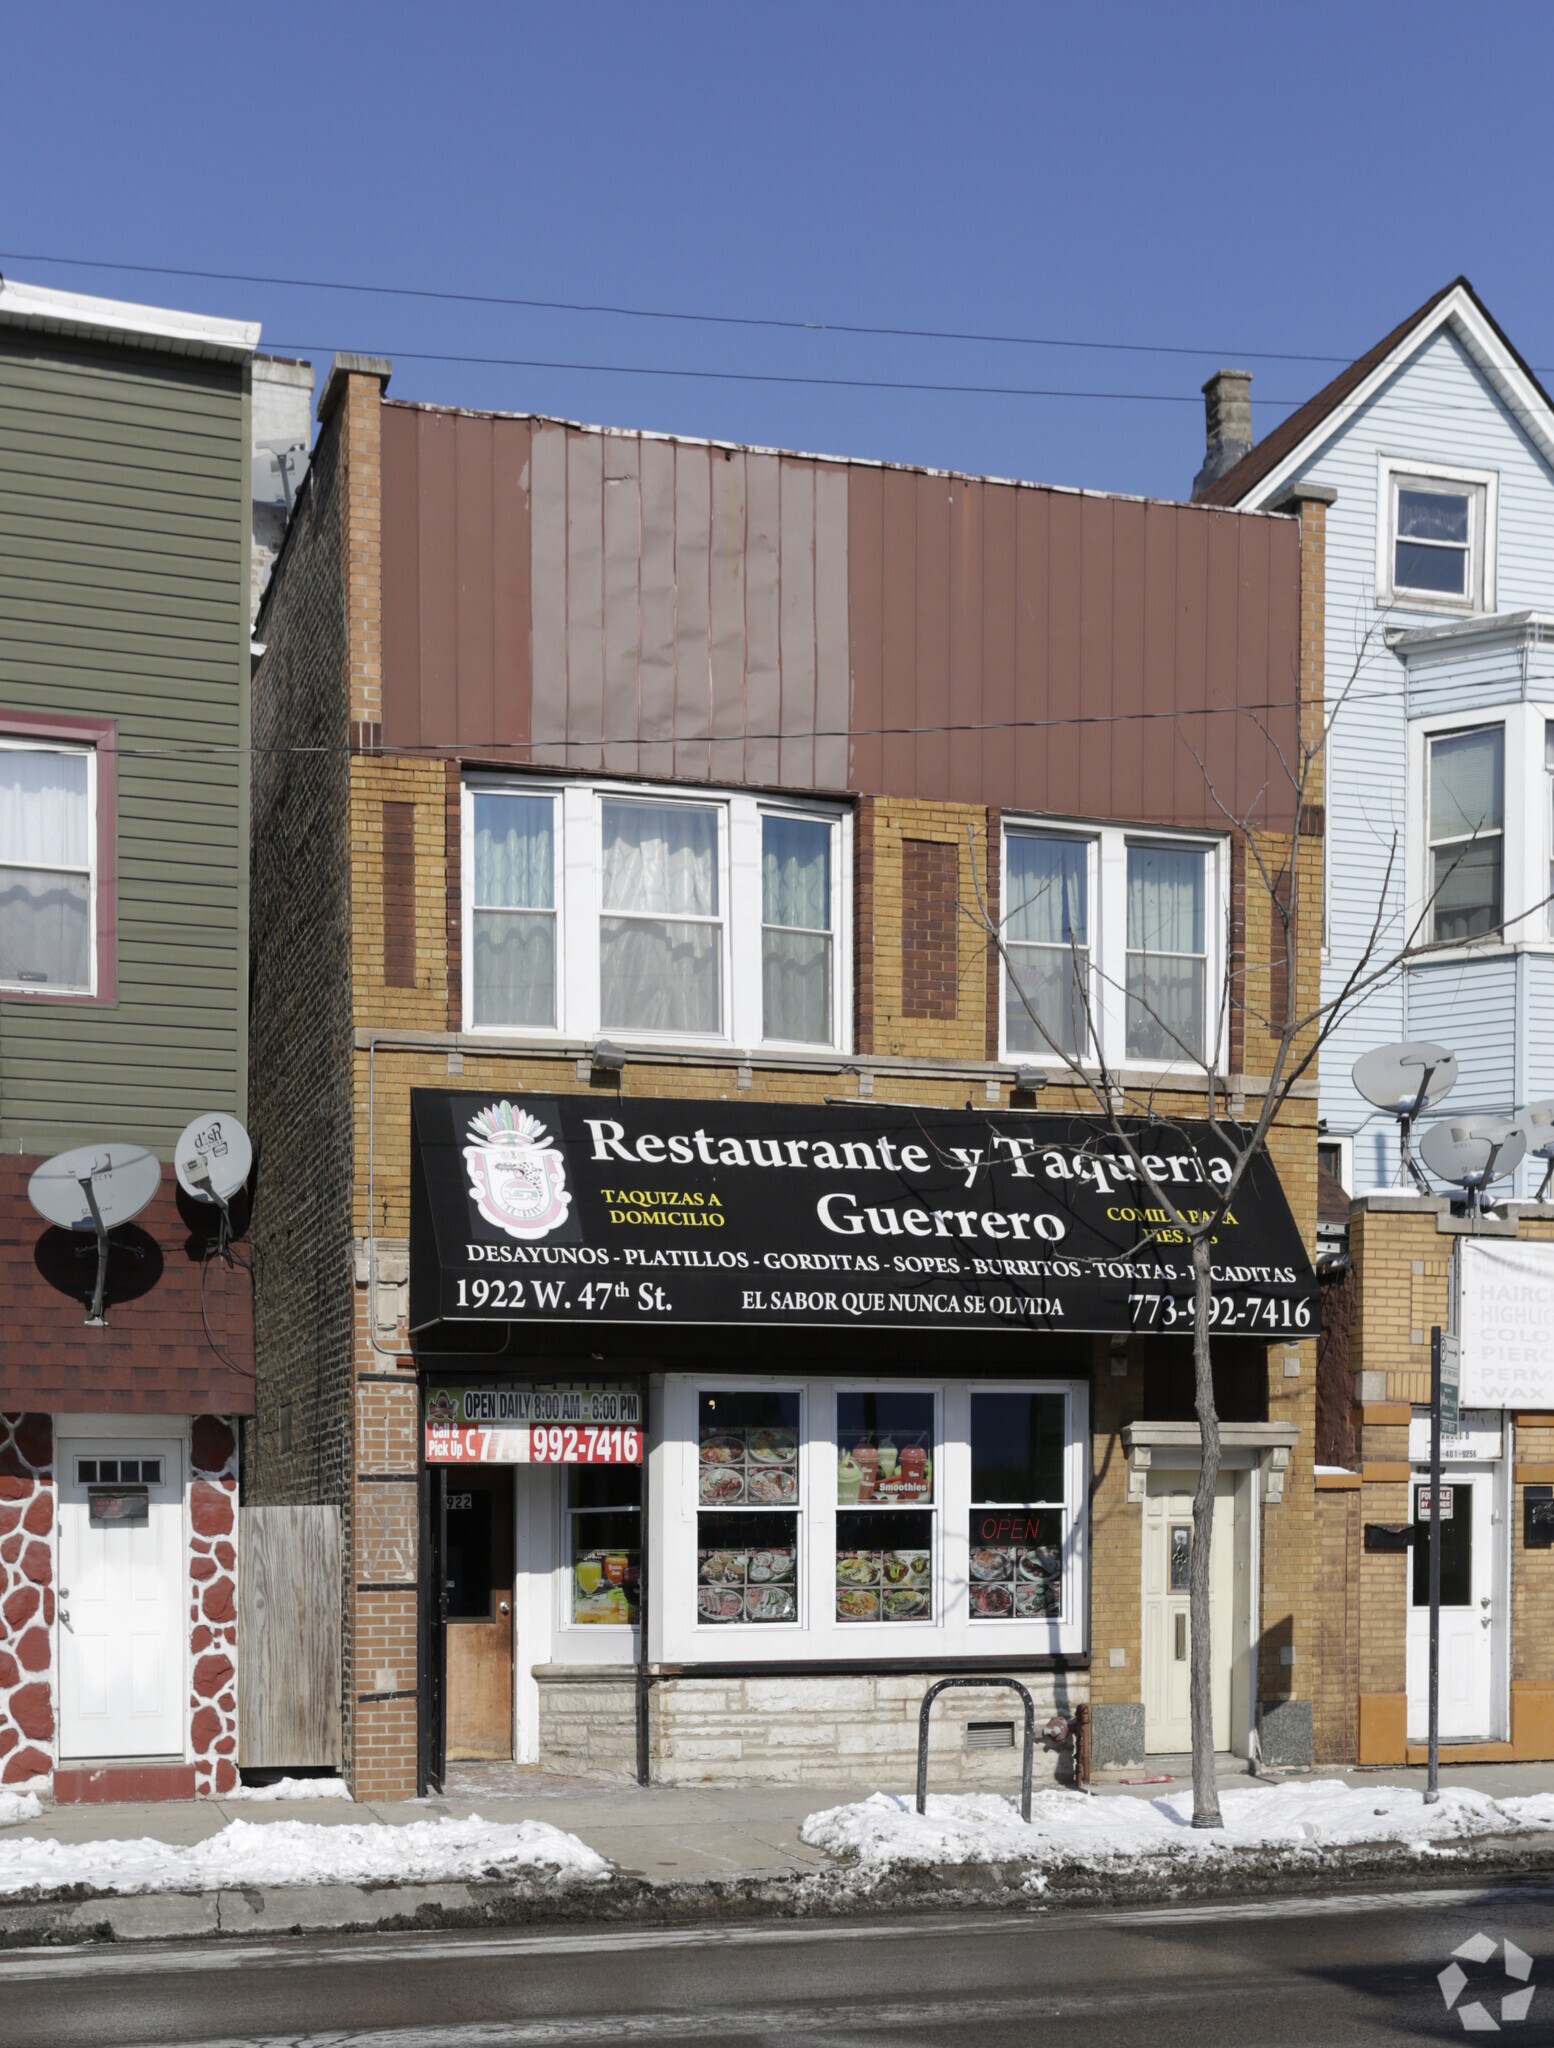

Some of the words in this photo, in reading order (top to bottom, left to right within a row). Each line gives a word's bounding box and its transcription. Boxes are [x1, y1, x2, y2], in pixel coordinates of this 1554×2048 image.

[194, 1127, 222, 1149] dish
[583, 1118, 931, 1173] Restaurante
[949, 1147, 984, 1188] y
[993, 1137, 1235, 1193] Taqueria
[601, 1189, 704, 1207] TAQUIZAS
[708, 1193, 723, 1206] A
[609, 1210, 725, 1227] DOMICILIO
[816, 1192, 1066, 1241] Guerrero
[1187, 1209, 1240, 1225] PAA
[1142, 1228, 1219, 1245] FIESS
[466, 1243, 609, 1265] DESAYUNOS
[624, 1248, 749, 1270] PLATILLOS
[763, 1253, 879, 1272] GORDITAS
[893, 1255, 960, 1275] SOPES
[973, 1258, 1081, 1278] BURRITOS
[1092, 1262, 1176, 1281] TORTAS
[1187, 1265, 1297, 1284] CADITAS
[456, 1279, 527, 1309] 1922
[530, 1280, 571, 1309] W.
[578, 1281, 631, 1310] 47th
[637, 1281, 673, 1311] St.
[741, 1290, 766, 1309] EL
[770, 1290, 838, 1311] SABOR
[841, 1292, 884, 1314] QUE
[888, 1293, 960, 1314] NUNCA
[963, 1295, 986, 1315] SE
[989, 1296, 1065, 1316] OLVIDA
[1480, 1386, 1546, 1400] WAX
[464, 1391, 496, 1419] OPEN
[499, 1391, 532, 1420] DAILY
[534, 1392, 560, 1420] 8:00
[562, 1393, 581, 1420] AM
[620, 1394, 639, 1421] PM
[432, 1422, 450, 1439] Call
[451, 1422, 460, 1439] &
[428, 1440, 449, 1457] Pick
[450, 1440, 463, 1460] Up
[533, 1425, 639, 1462] 992-7416
[879, 1482, 927, 1492] Smoothies
[981, 1518, 1041, 1540] OPEN
